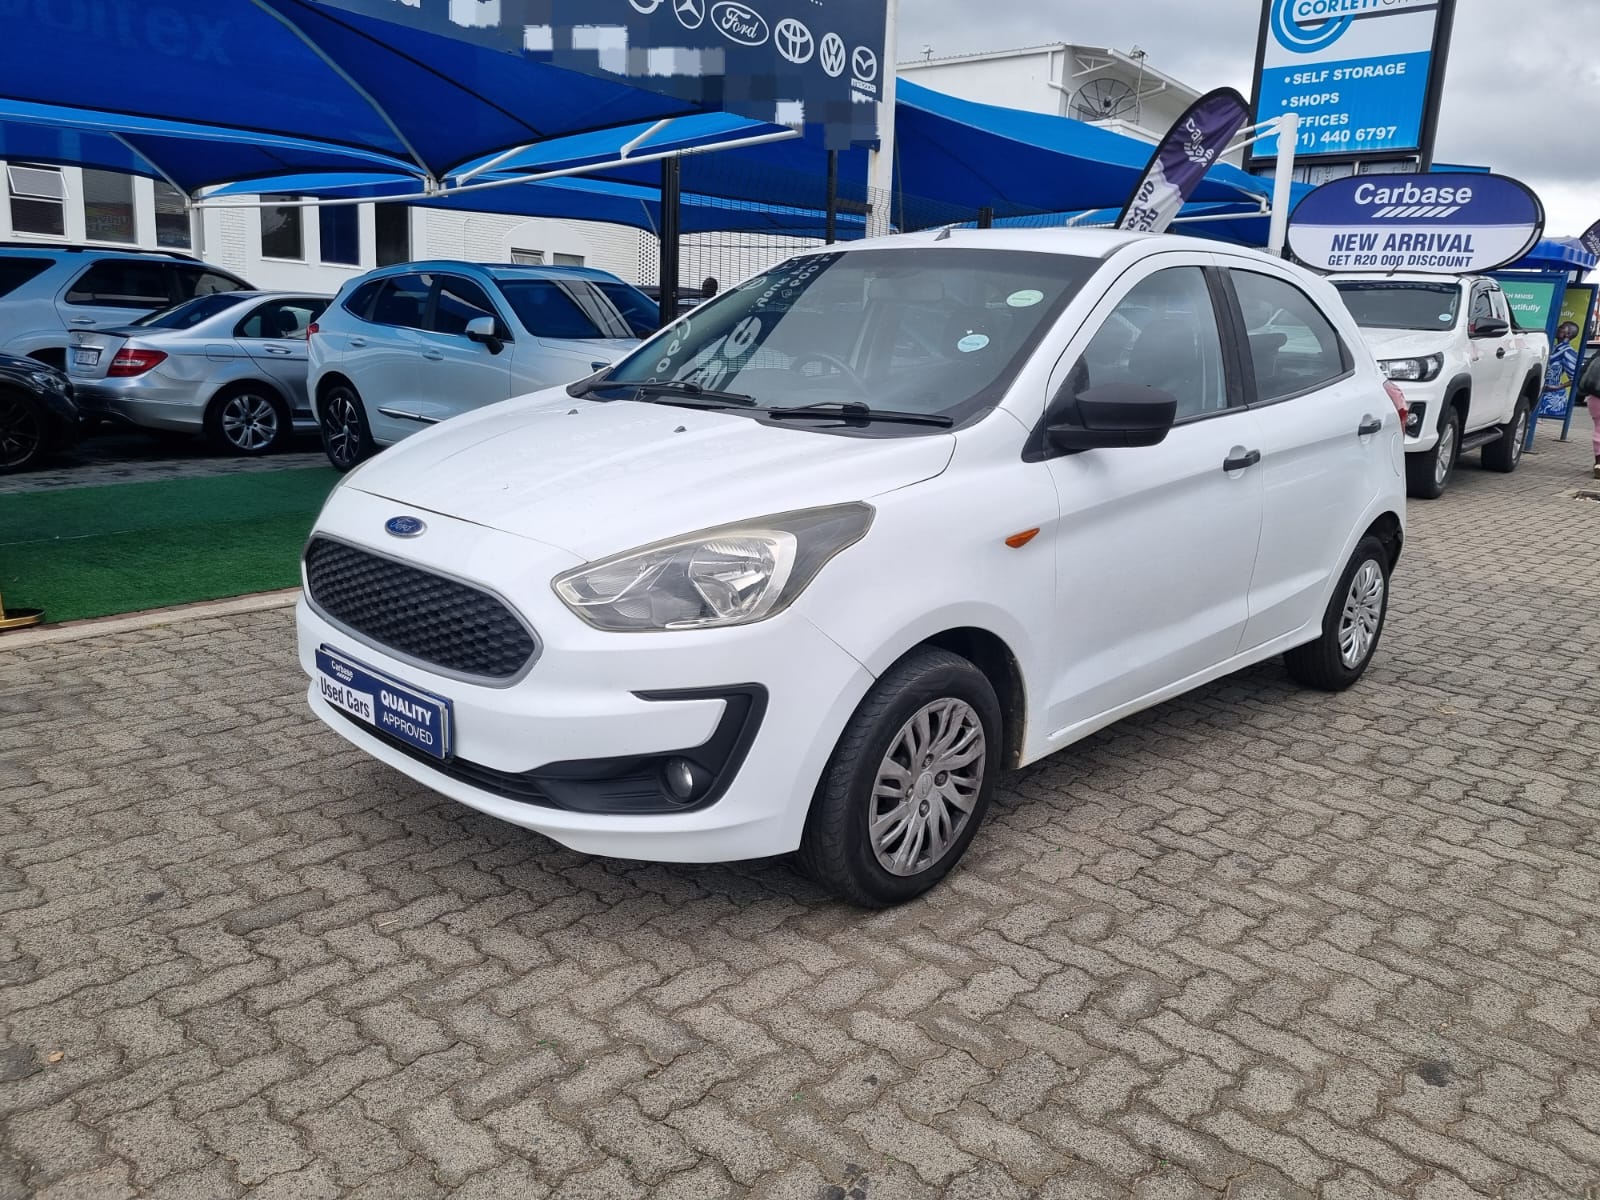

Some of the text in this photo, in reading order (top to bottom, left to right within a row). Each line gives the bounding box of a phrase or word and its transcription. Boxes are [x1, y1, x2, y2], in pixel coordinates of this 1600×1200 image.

[1292, 62, 1407, 85] SELF STORAGE
[1289, 92, 1340, 108] SHOPS
[1298, 113, 1349, 128] FFICES
[1320, 130, 1351, 144] 440
[1355, 126, 1398, 141] 6797
[1354, 182, 1473, 205] Carbase
[1331, 233, 1475, 253] NEW ARRIVAL
[1328, 254, 1473, 267] GET R20 000 DISCOUNT
[331, 660, 354, 677] Carbase
[320, 676, 370, 719] Used Cars
[380, 689, 432, 726] QUALITY
[383, 711, 433, 745] APPROVED
